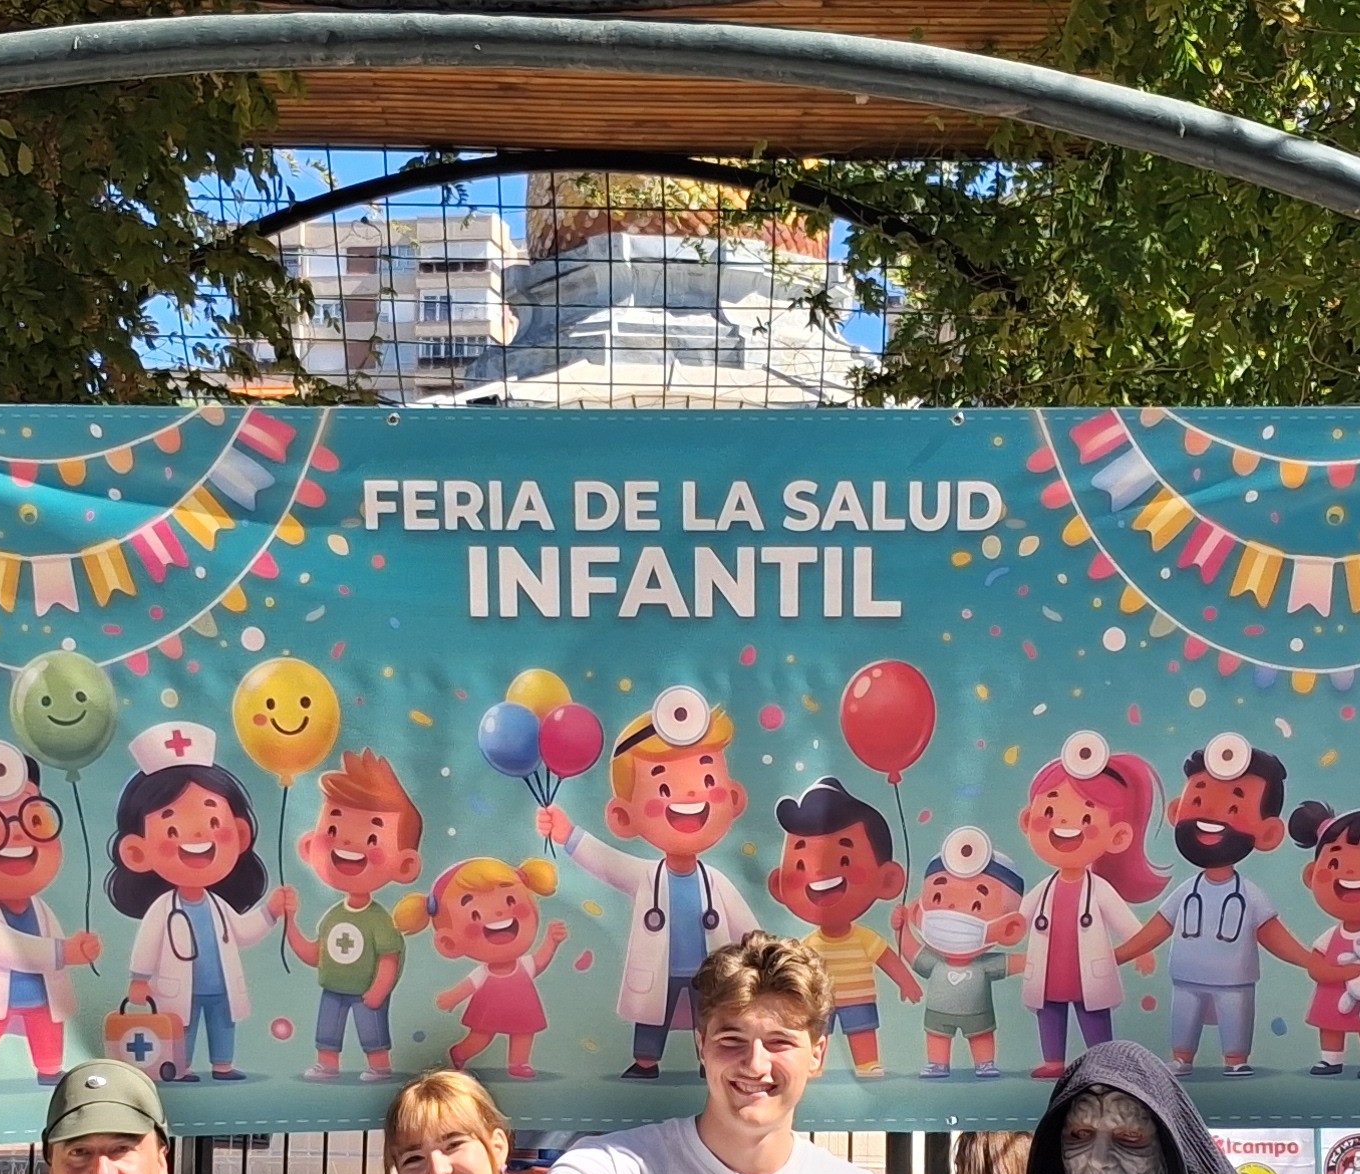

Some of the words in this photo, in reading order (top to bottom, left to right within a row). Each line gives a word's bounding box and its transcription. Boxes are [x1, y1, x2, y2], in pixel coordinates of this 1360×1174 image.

[363, 481, 555, 531] FERIA
[574, 481, 660, 531] DE
[682, 481, 764, 531] LA
[782, 481, 1003, 532] SALUD
[468, 547, 902, 618] INFANTIL
